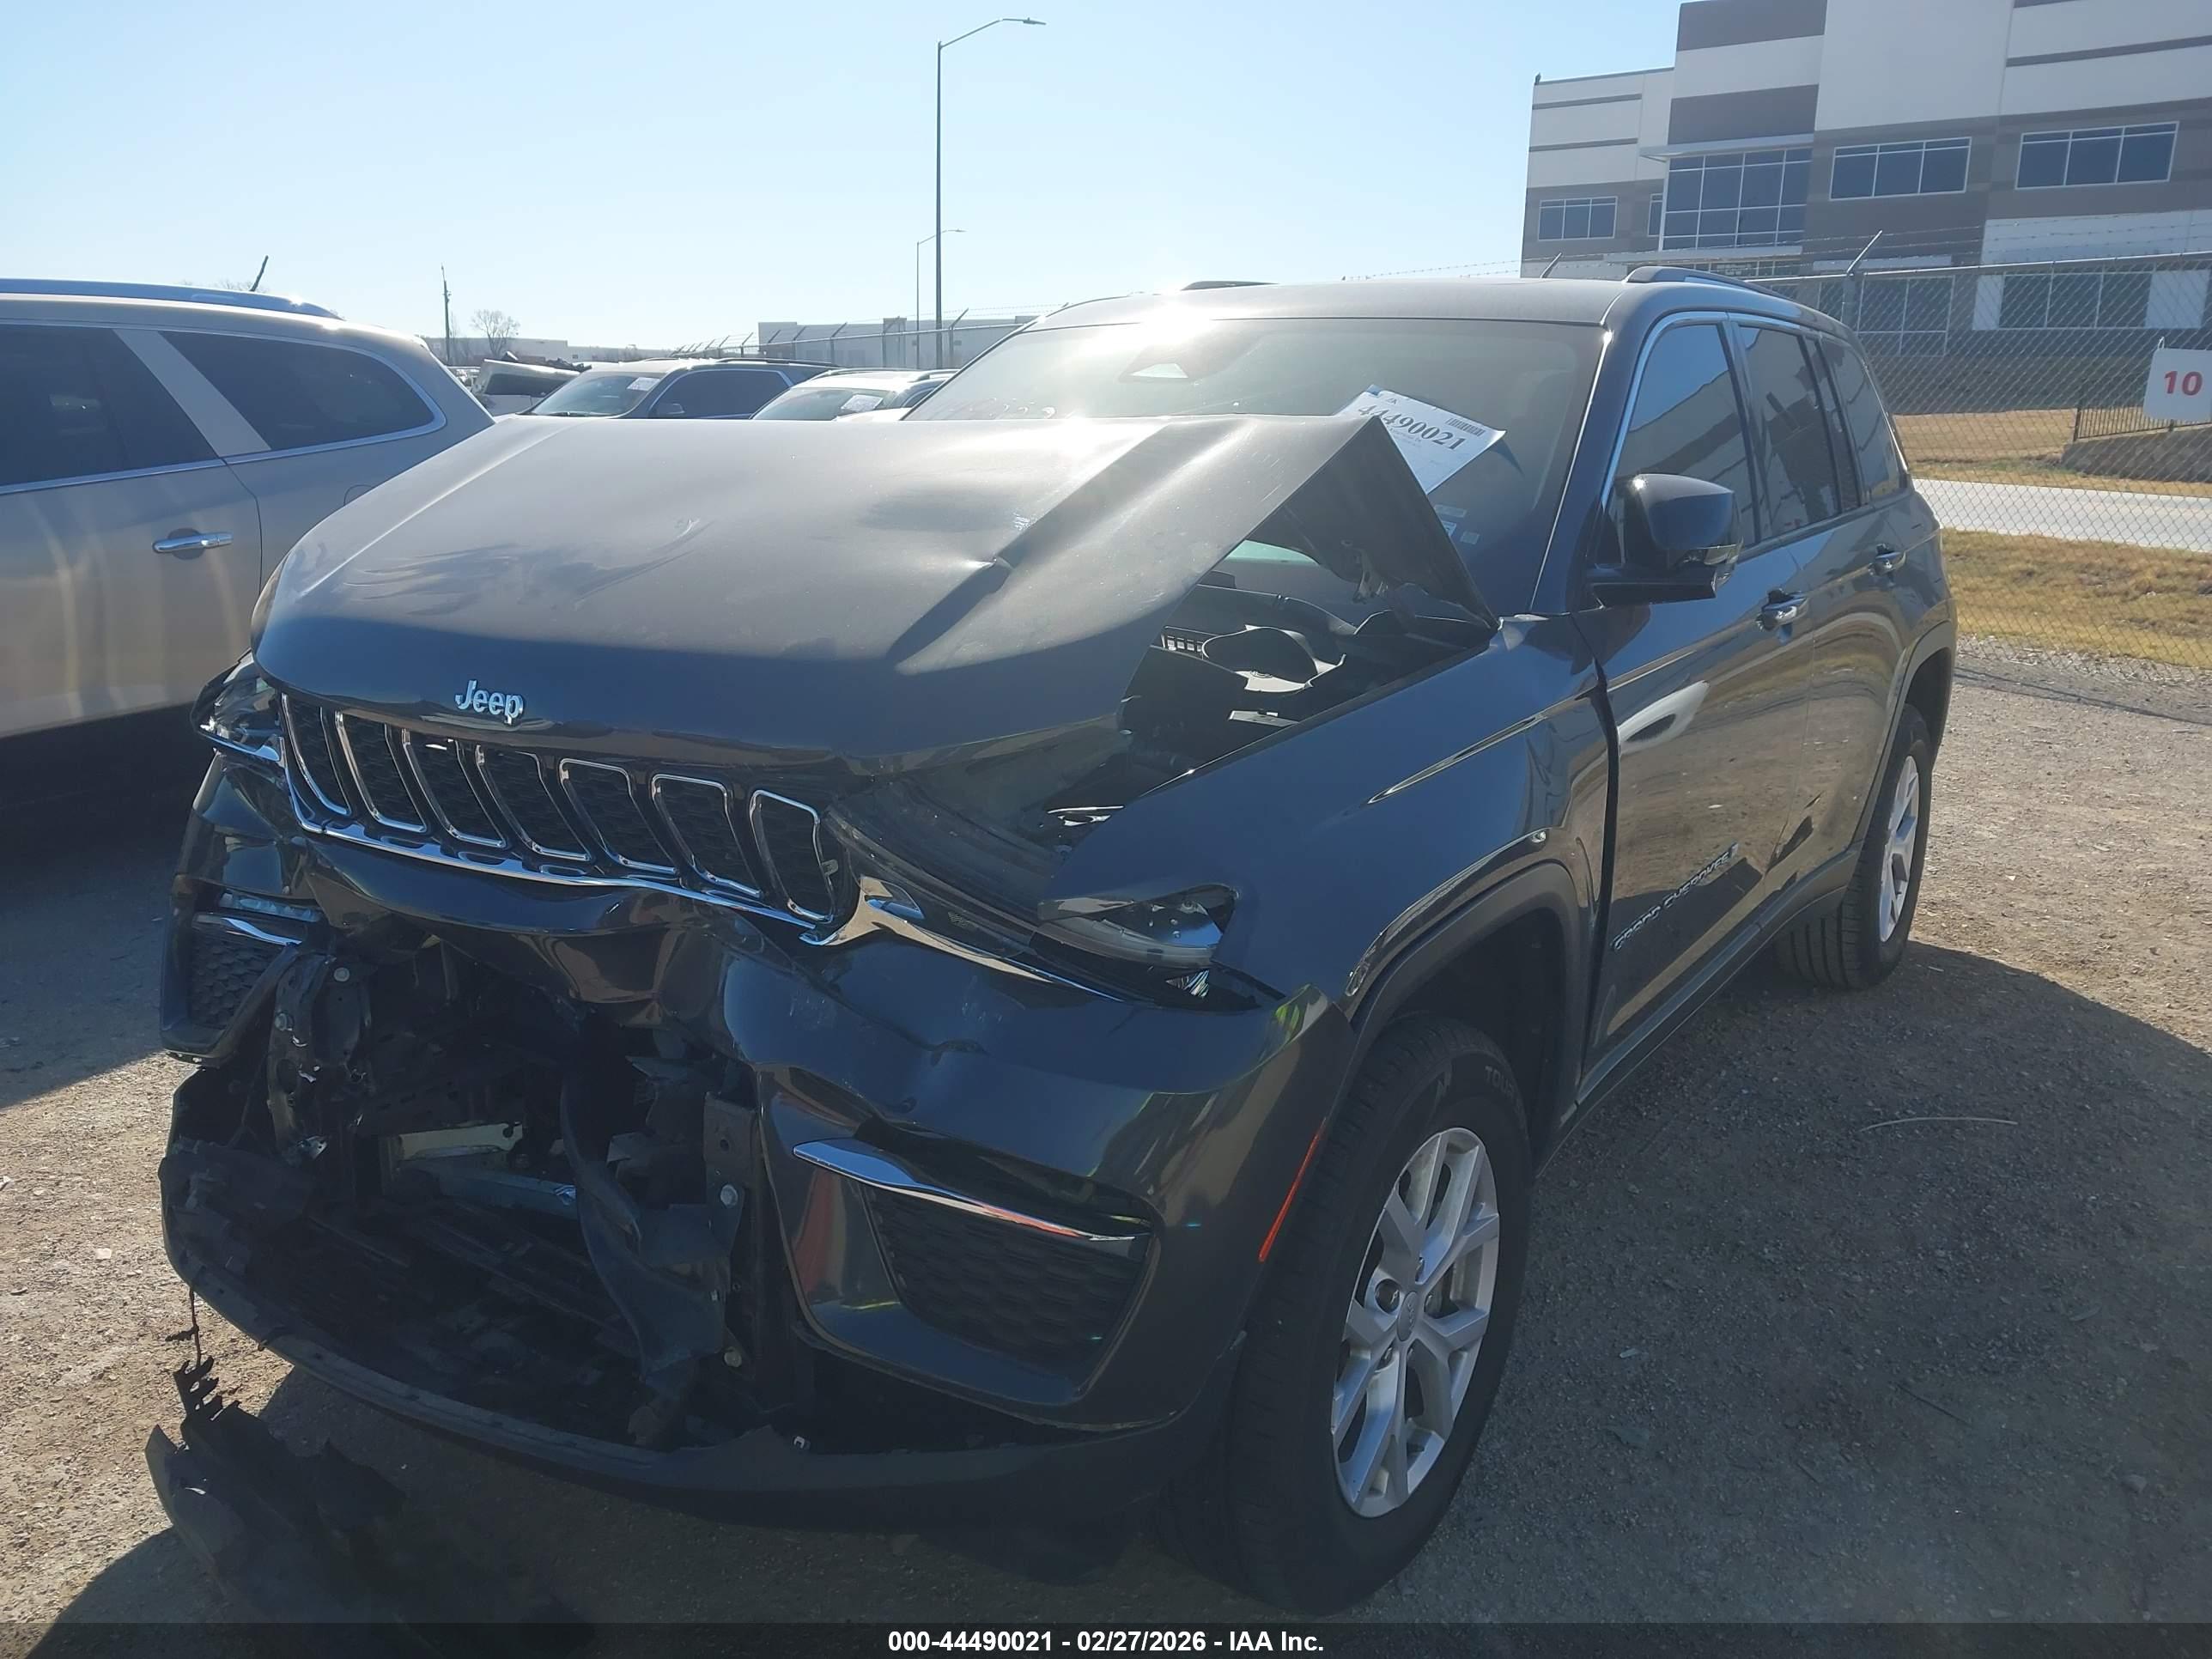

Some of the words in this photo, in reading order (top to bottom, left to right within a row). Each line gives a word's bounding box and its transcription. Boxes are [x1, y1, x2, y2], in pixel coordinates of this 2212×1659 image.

[2164, 370, 2203, 396] 10
[1358, 404, 1466, 450] 44490021
[454, 679, 524, 726] Jeep
